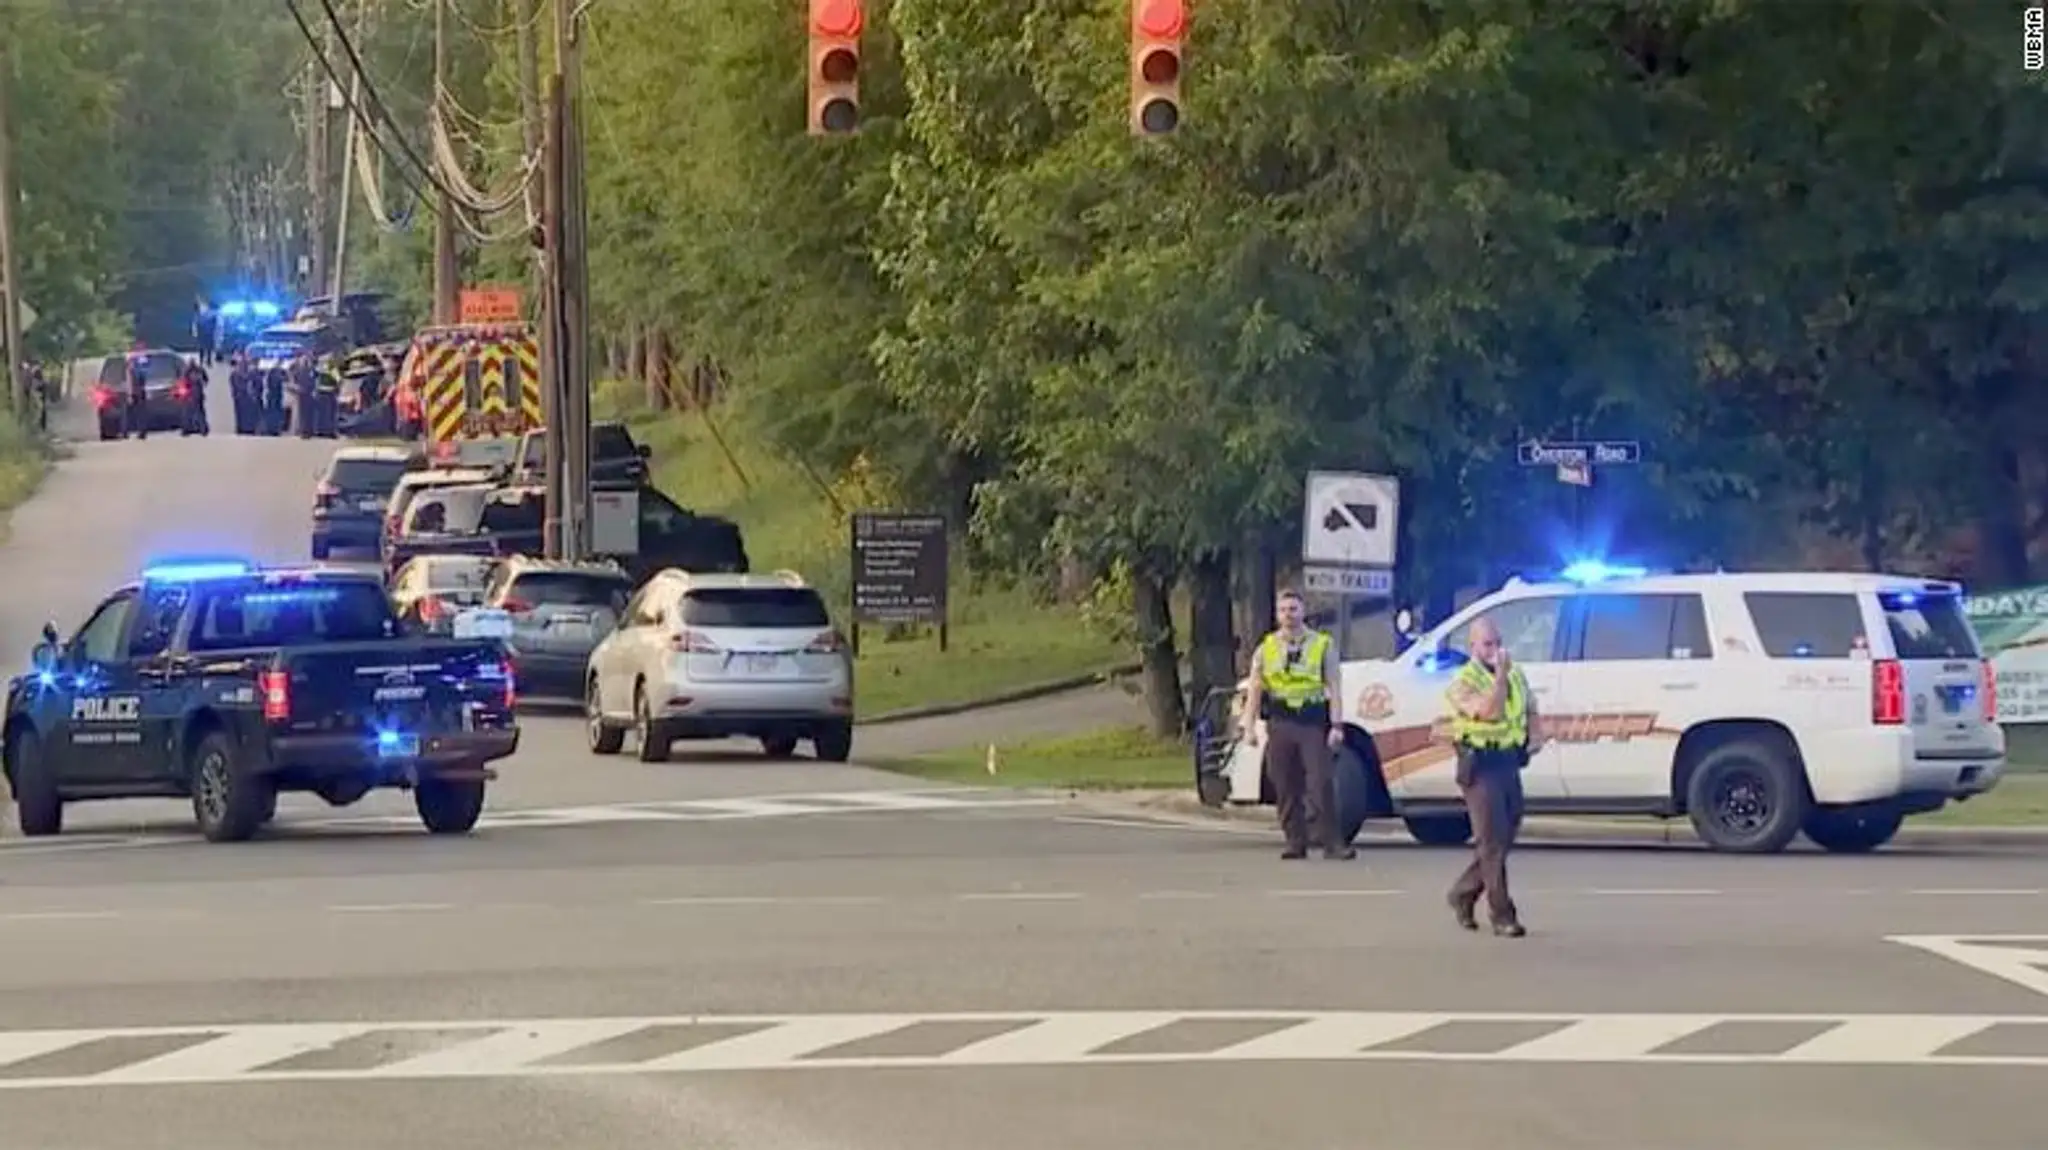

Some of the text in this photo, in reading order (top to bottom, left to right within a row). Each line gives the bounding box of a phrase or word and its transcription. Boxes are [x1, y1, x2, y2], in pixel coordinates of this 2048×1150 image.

[1307, 572, 1388, 588] WITH TRAILER
[71, 697, 141, 720] POLICE
